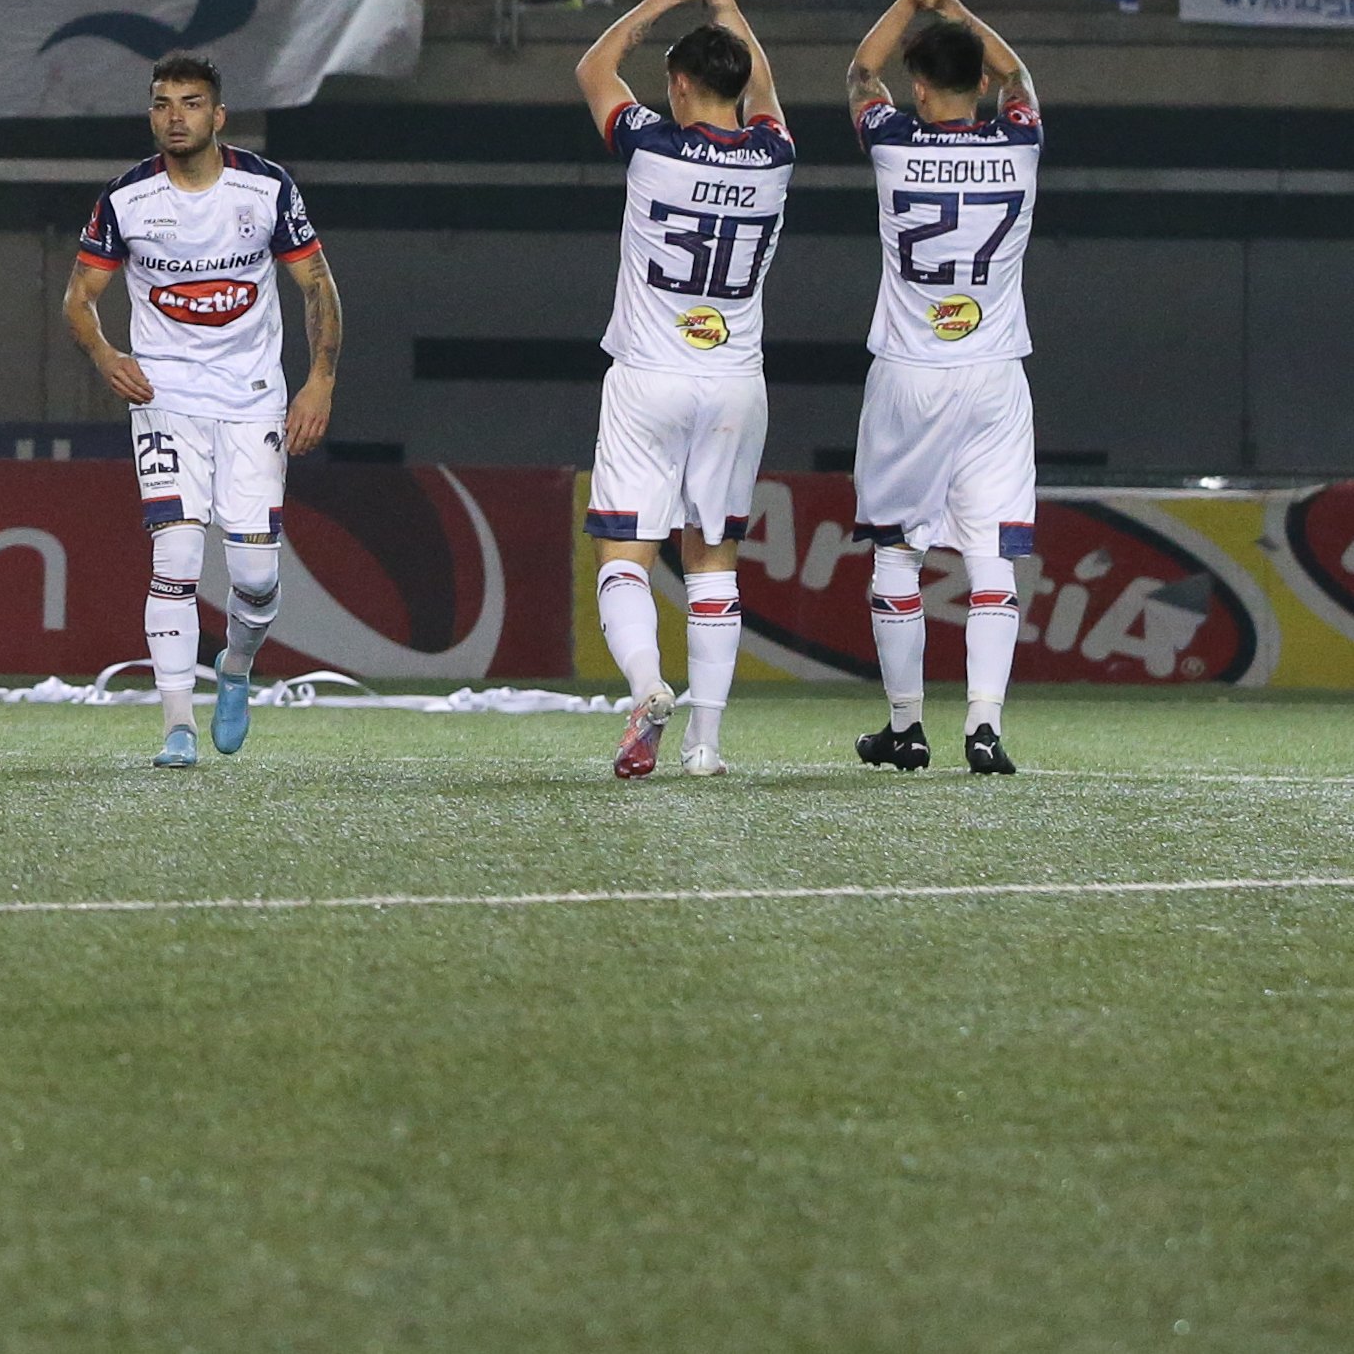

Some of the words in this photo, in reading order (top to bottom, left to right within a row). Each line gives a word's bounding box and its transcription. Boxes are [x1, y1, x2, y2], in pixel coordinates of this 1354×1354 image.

[647, 200, 780, 300] 30
[893, 190, 1026, 285] 27
[137, 431, 179, 475] 25
